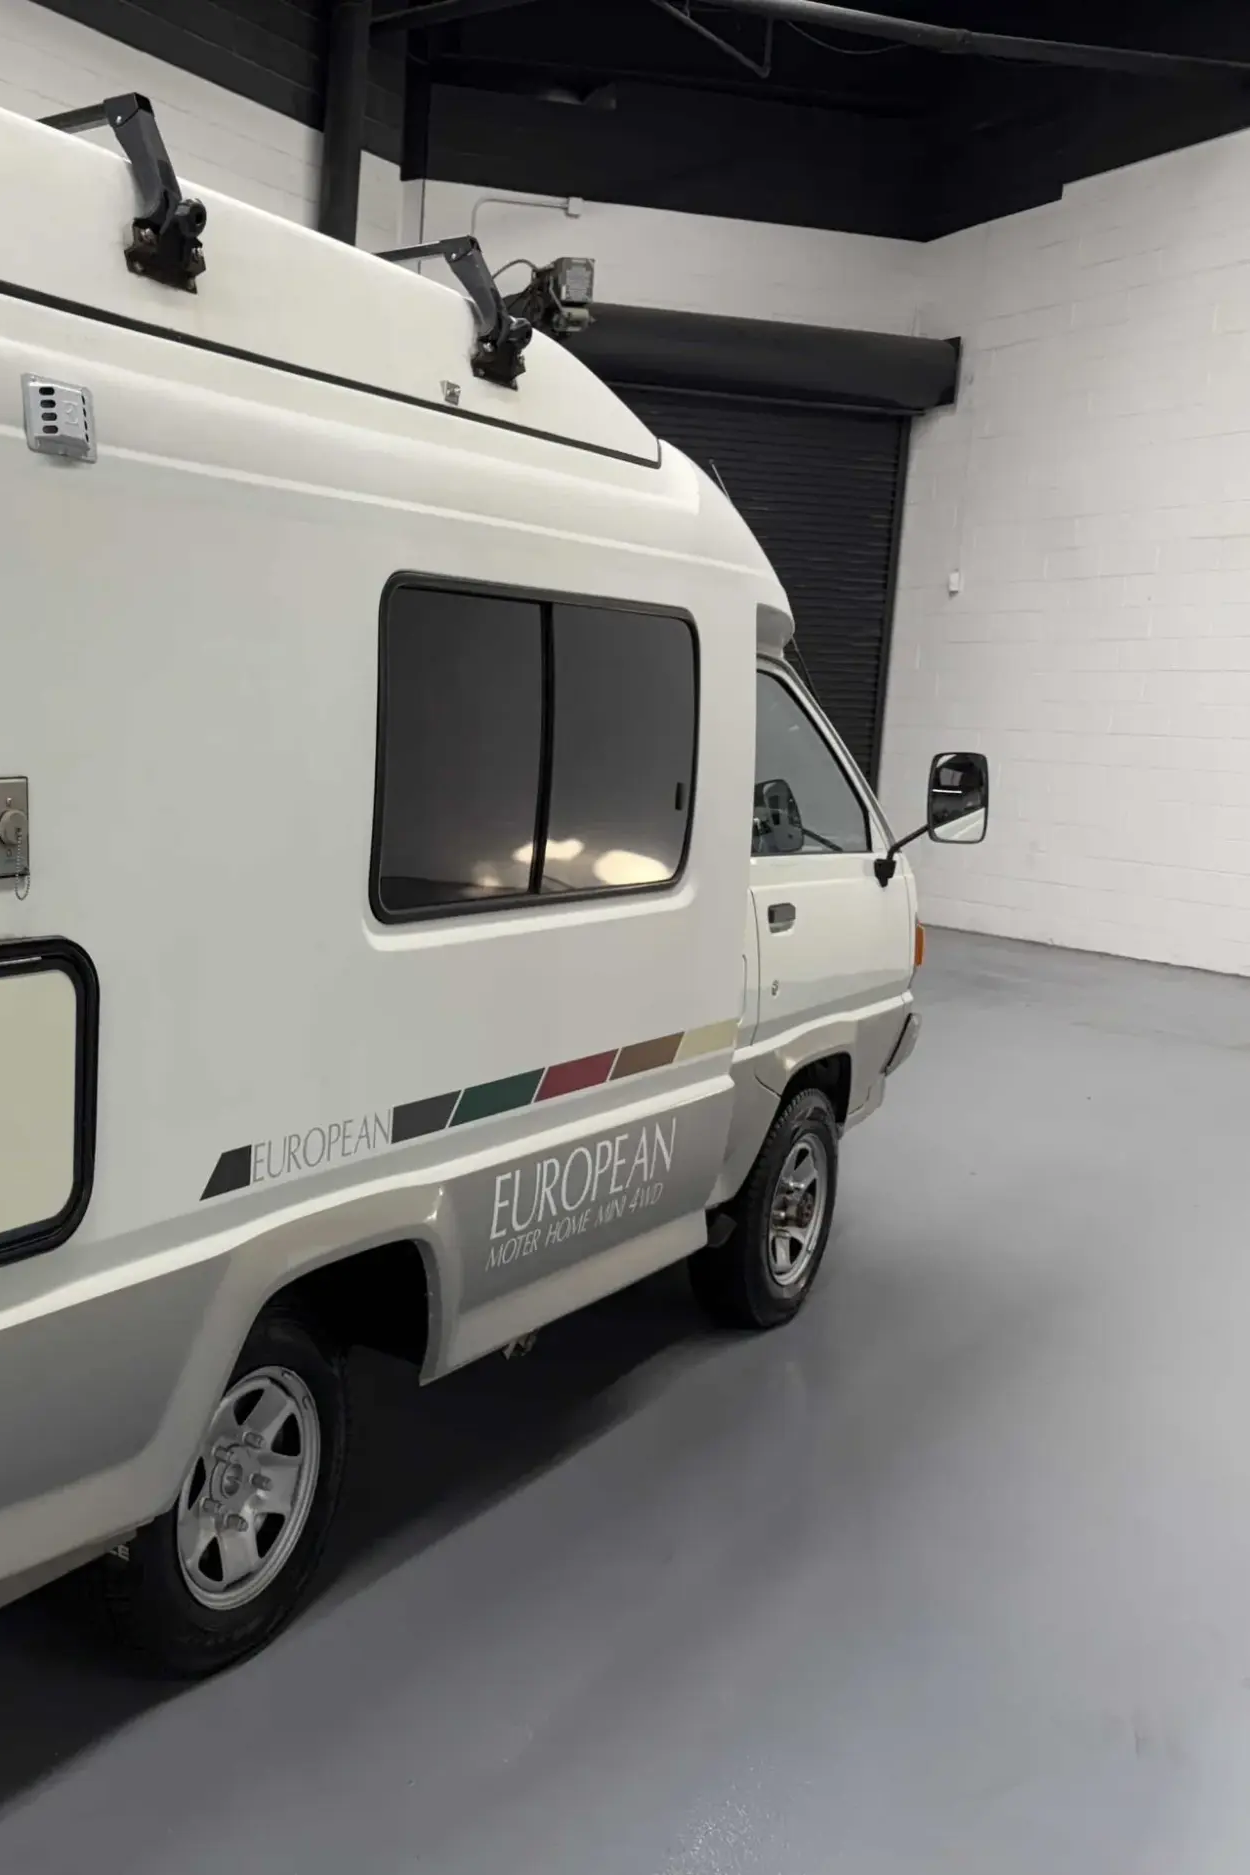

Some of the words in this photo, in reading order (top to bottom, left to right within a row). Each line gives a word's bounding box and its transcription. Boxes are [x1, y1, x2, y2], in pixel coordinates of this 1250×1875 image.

[252, 1109, 392, 1183] EUROPEAN
[489, 1117, 677, 1240] EUROPEAN
[485, 1228, 541, 1272] MOTER
[545, 1209, 591, 1247] HOME
